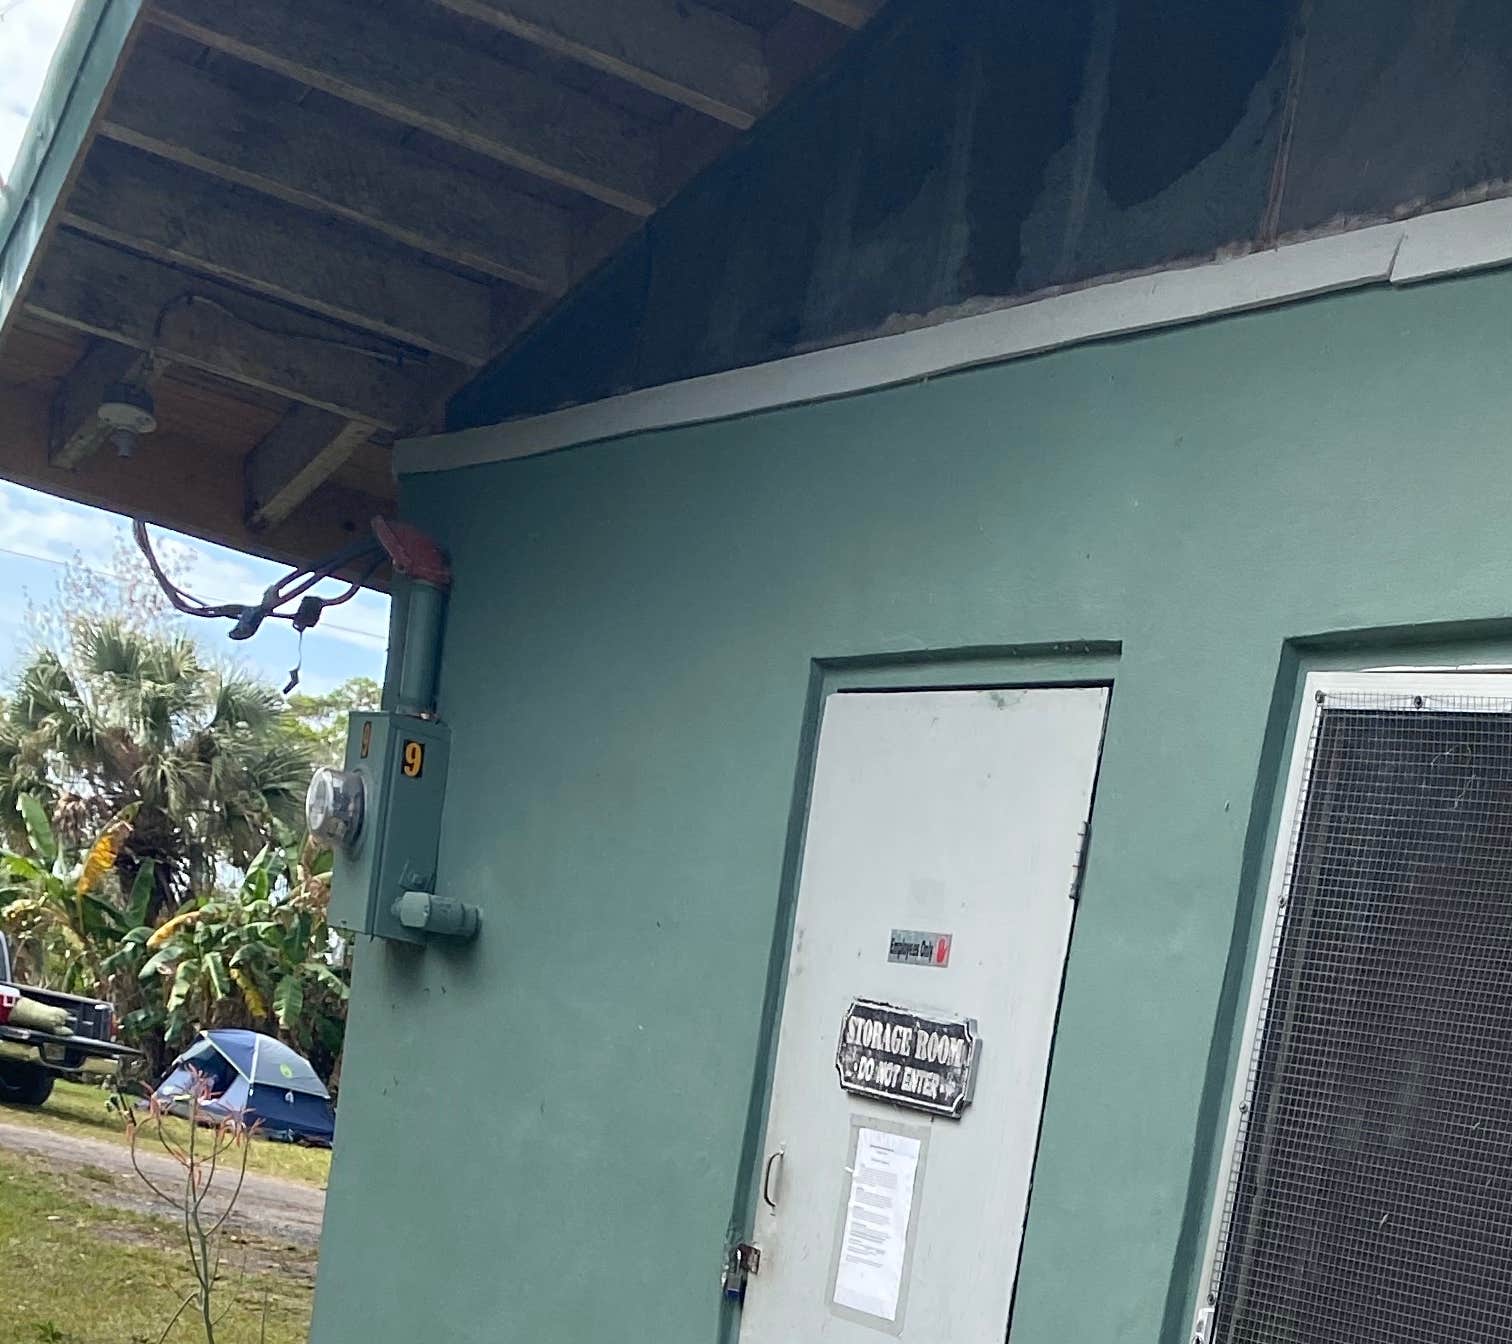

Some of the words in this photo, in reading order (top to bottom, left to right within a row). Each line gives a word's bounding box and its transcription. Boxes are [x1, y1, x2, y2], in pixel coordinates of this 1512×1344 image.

[404, 742, 422, 777] 9
[846, 1015, 912, 1057] STORAGE
[914, 1029, 967, 1067] ROOM
[857, 1056, 875, 1081] DO
[876, 1060, 901, 1088] NOT
[901, 1066, 941, 1100] ENTER
